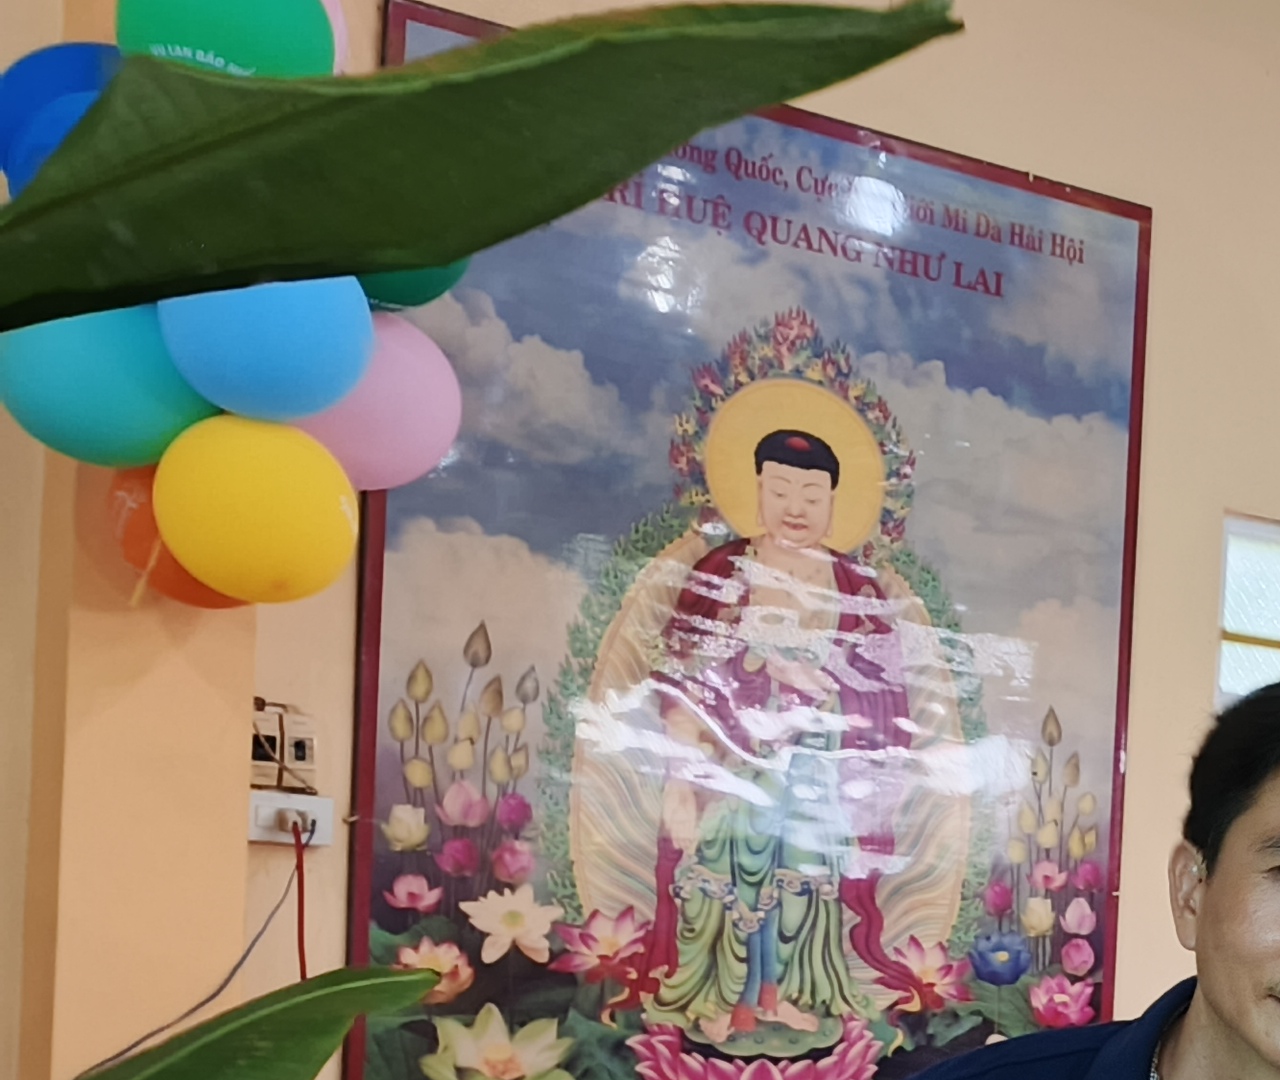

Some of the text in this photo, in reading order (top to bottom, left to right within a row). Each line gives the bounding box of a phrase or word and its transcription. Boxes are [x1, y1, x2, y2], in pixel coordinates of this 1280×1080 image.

[724, 146, 789, 189] Quốc,
[1008, 220, 1044, 254] Hải
[1049, 231, 1085, 266] Hội
[742, 210, 863, 264] QUANG
[872, 240, 948, 283] NHƯ
[952, 260, 1006, 298] LAI
